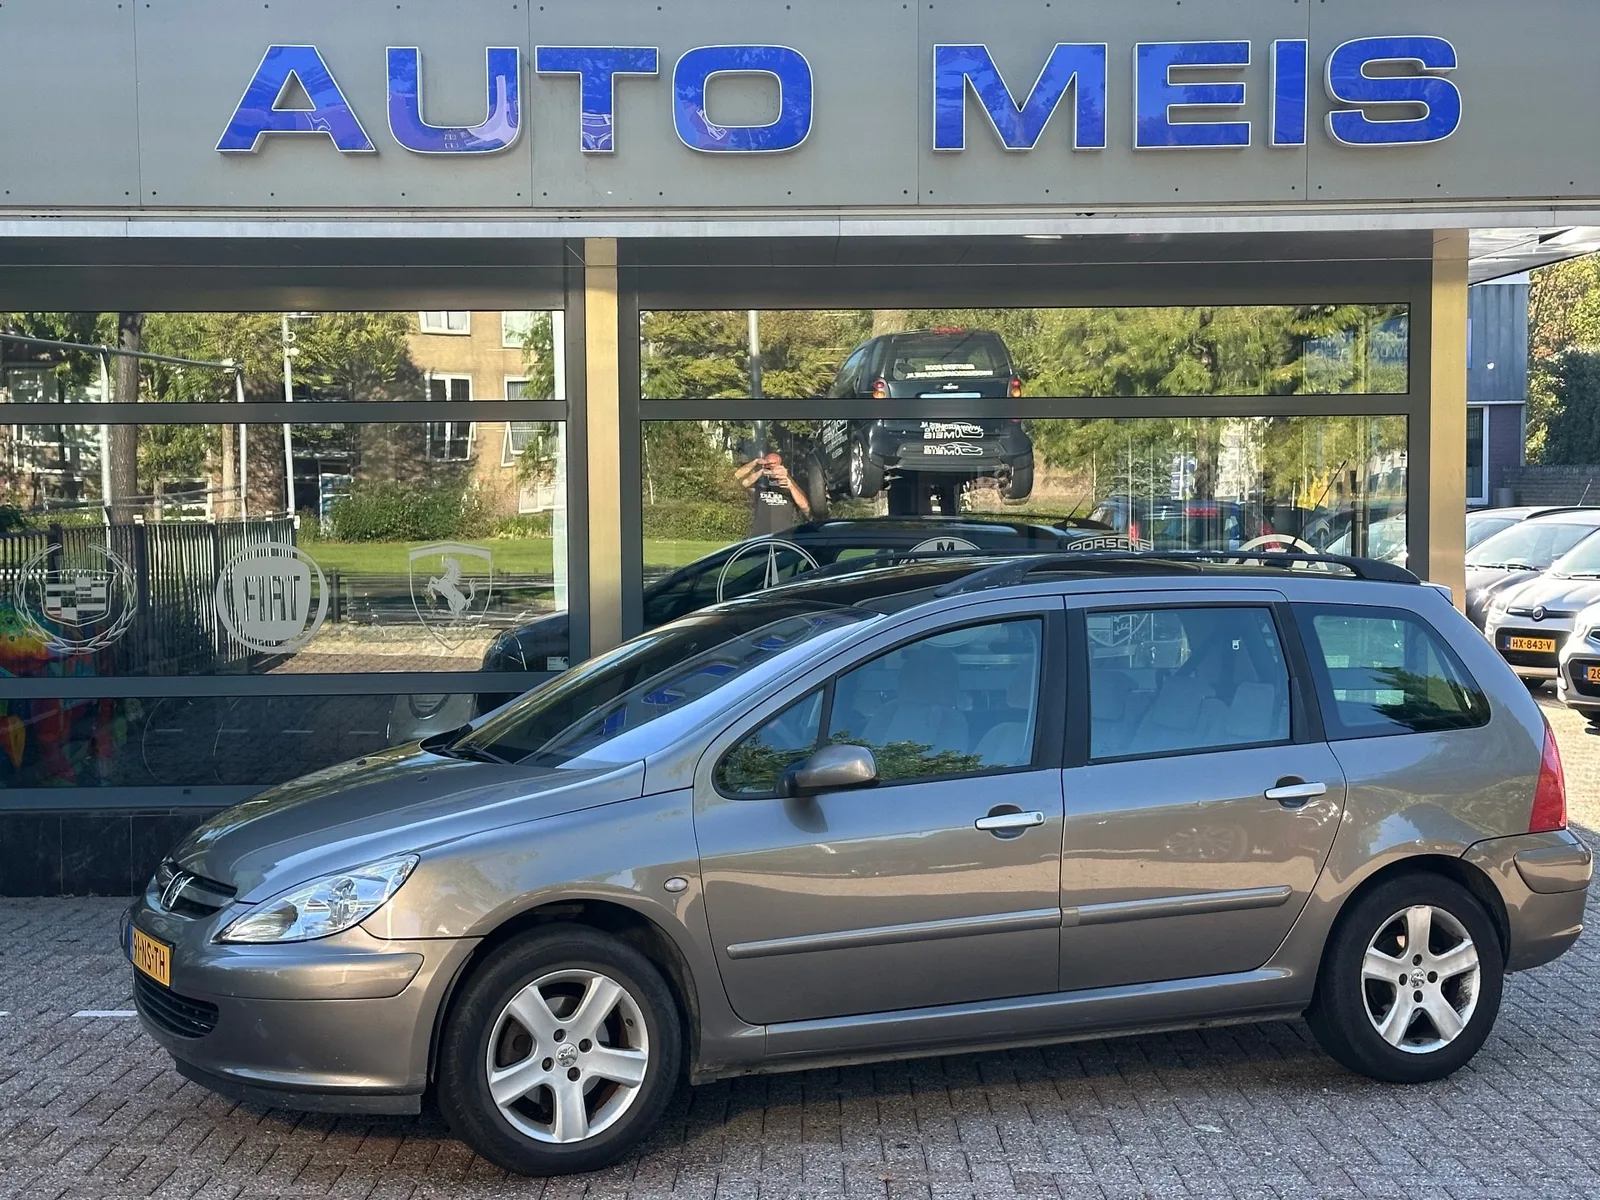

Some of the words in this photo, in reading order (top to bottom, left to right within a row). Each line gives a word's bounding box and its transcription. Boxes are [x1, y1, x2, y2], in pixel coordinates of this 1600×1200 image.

[214, 44, 814, 154] AUTO
[932, 35, 1463, 153] MEIS
[1070, 538, 1153, 552] PORSCHE
[243, 575, 301, 622] FIAT
[1512, 638, 1552, 651] HX-843-V
